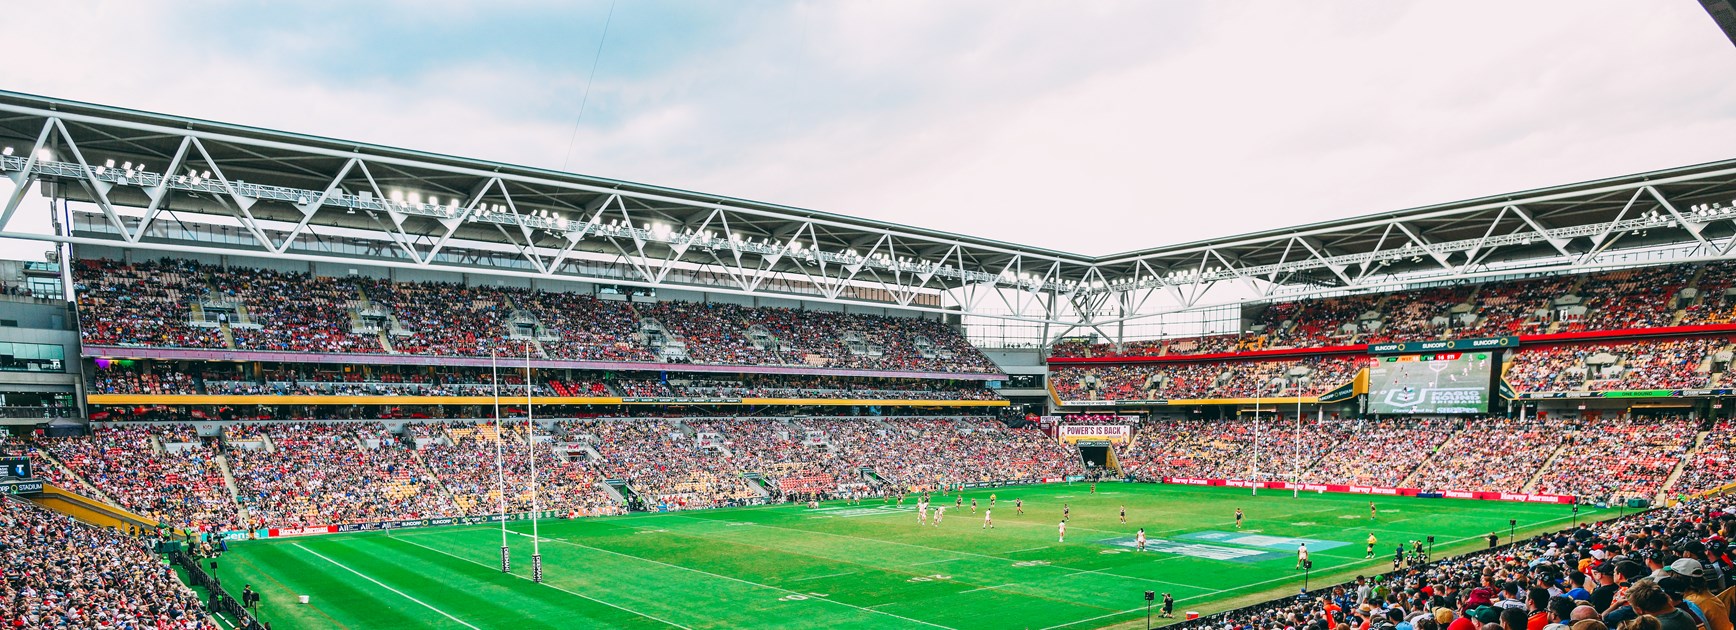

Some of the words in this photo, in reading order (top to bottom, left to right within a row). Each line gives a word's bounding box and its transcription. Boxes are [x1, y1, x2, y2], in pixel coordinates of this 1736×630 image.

[1067, 426, 1094, 434] POWER'S
[1096, 426, 1102, 434] IS
[1105, 426, 1121, 434] BACK
[19, 483, 42, 491] STADIUM
[1349, 486, 1372, 494] Harvey
[1501, 492, 1527, 502] Harvey
[1528, 494, 1559, 502] Norman
